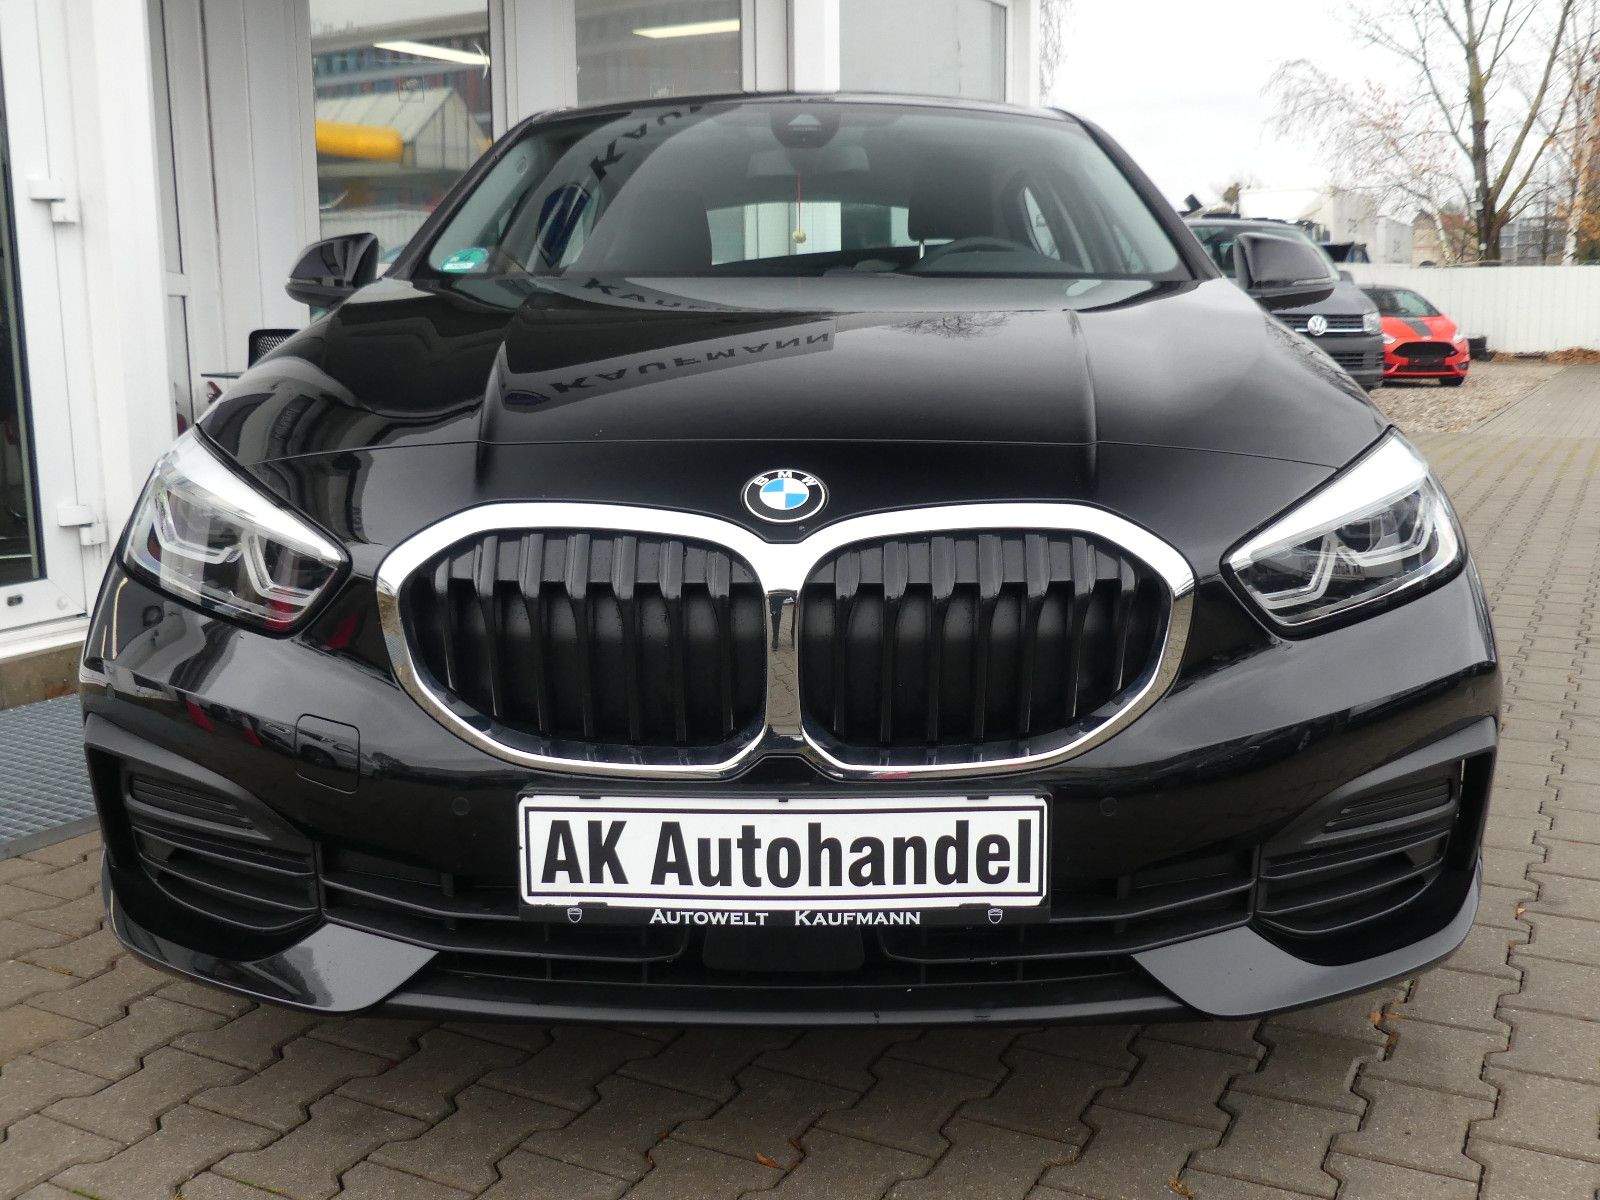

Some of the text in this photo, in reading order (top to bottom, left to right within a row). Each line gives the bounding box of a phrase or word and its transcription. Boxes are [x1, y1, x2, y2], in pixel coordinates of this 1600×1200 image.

[753, 470, 818, 487] BMW
[541, 818, 1032, 888] AK Autohandel
[649, 908, 921, 926] AUTOWELT KAUFMANN
